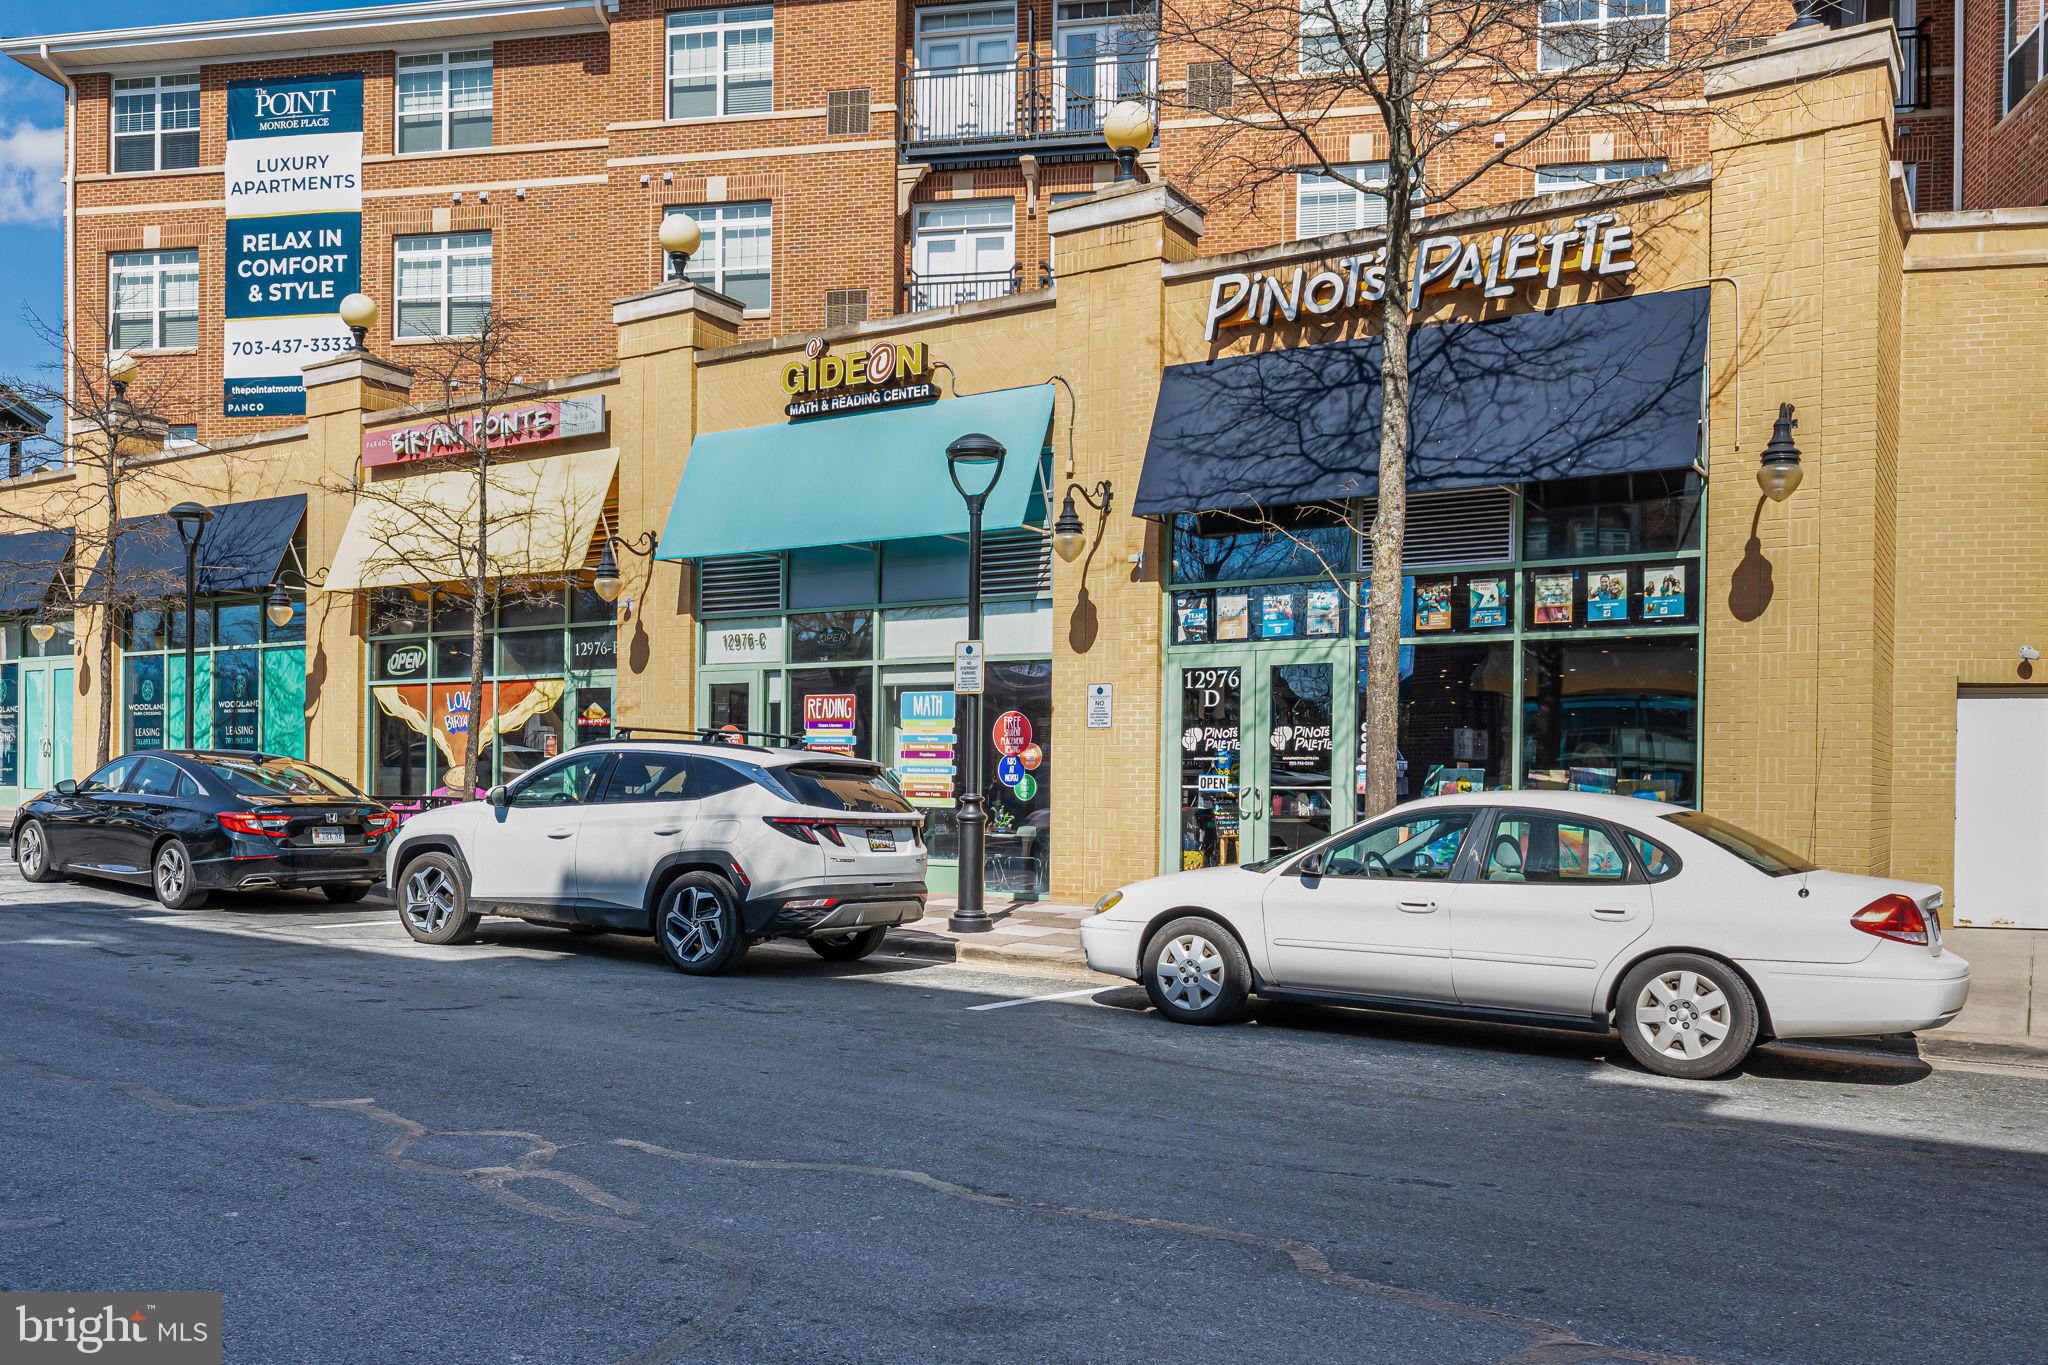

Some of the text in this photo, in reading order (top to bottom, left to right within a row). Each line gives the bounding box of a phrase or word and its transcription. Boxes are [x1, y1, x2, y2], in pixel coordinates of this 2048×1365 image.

[255, 89, 336, 117] POINT
[259, 117, 330, 131] MONROE PLACE
[256, 154, 330, 173] LUXURY
[231, 174, 356, 196] APARTMENTS
[243, 228, 342, 253] RELAX IN
[237, 254, 348, 279] COMFORT
[1409, 214, 1637, 311] PALETTE
[248, 280, 335, 303] & STYLE
[232, 336, 352, 356] 703-437-3333
[228, 402, 264, 413] PANCO
[790, 384, 930, 415] MATH & READING CENTER
[722, 632, 767, 650] 12976-C
[820, 633, 847, 643] OPEN
[390, 652, 422, 670] OPEN
[1184, 669, 1240, 689] 12976
[129, 703, 165, 711] WOODLAND
[218, 700, 260, 708] WOODLAND
[446, 691, 471, 711] LOV
[913, 695, 943, 716] MATH
[1203, 689, 1220, 707] D
[807, 697, 852, 719] READING
[225, 725, 254, 736] LEASING
[1003, 716, 1021, 729] FREE
[135, 727, 160, 737] LEASING
[1205, 738, 1240, 751] PALETTE
[1295, 737, 1333, 751] PALETTE
[1200, 777, 1226, 789] OPEN
